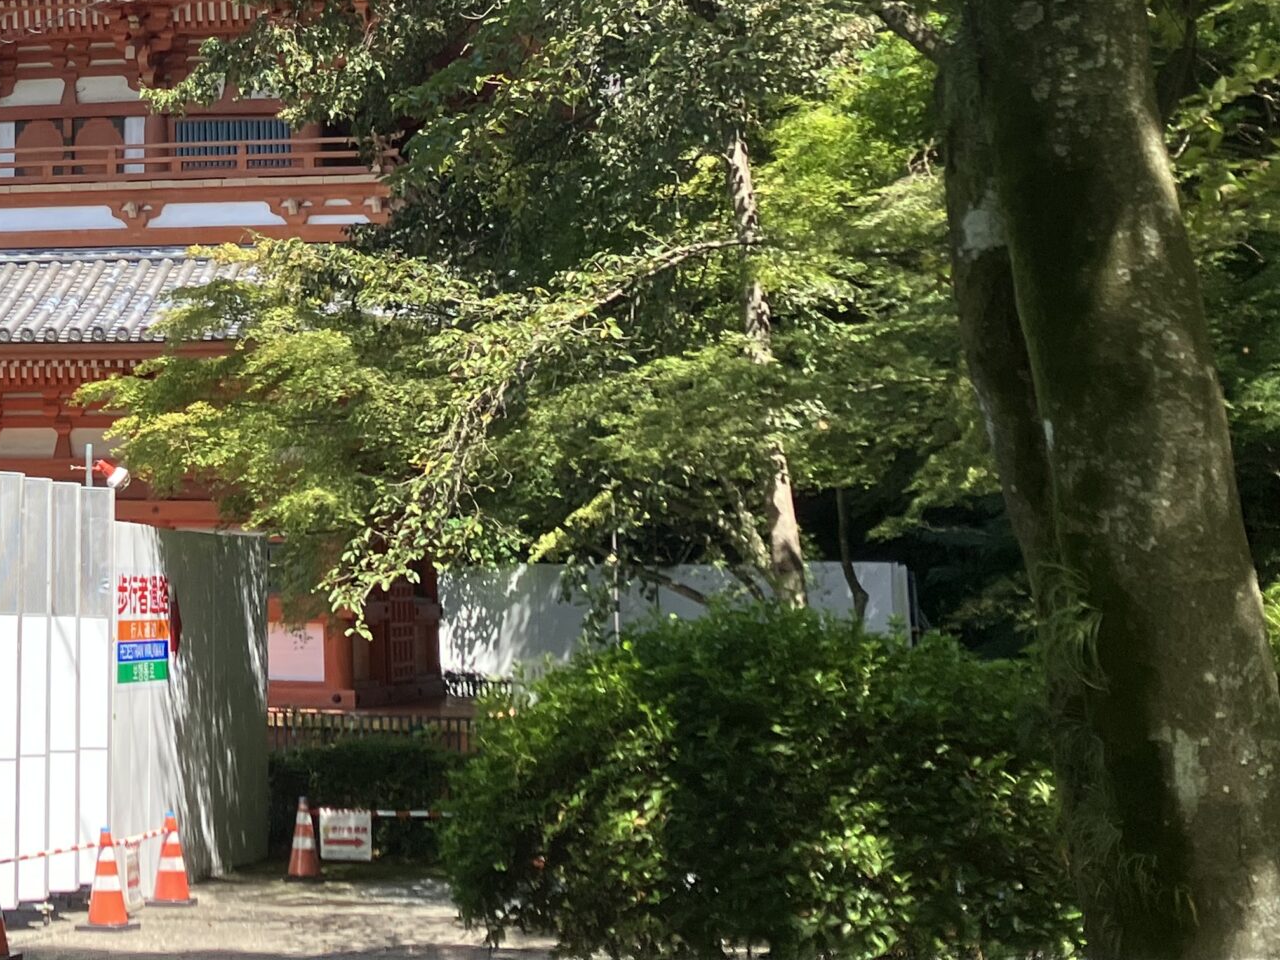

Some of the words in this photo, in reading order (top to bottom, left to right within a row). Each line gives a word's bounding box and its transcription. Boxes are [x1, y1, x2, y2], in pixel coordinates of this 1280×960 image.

[118, 574, 170, 615] 歩行者通路
